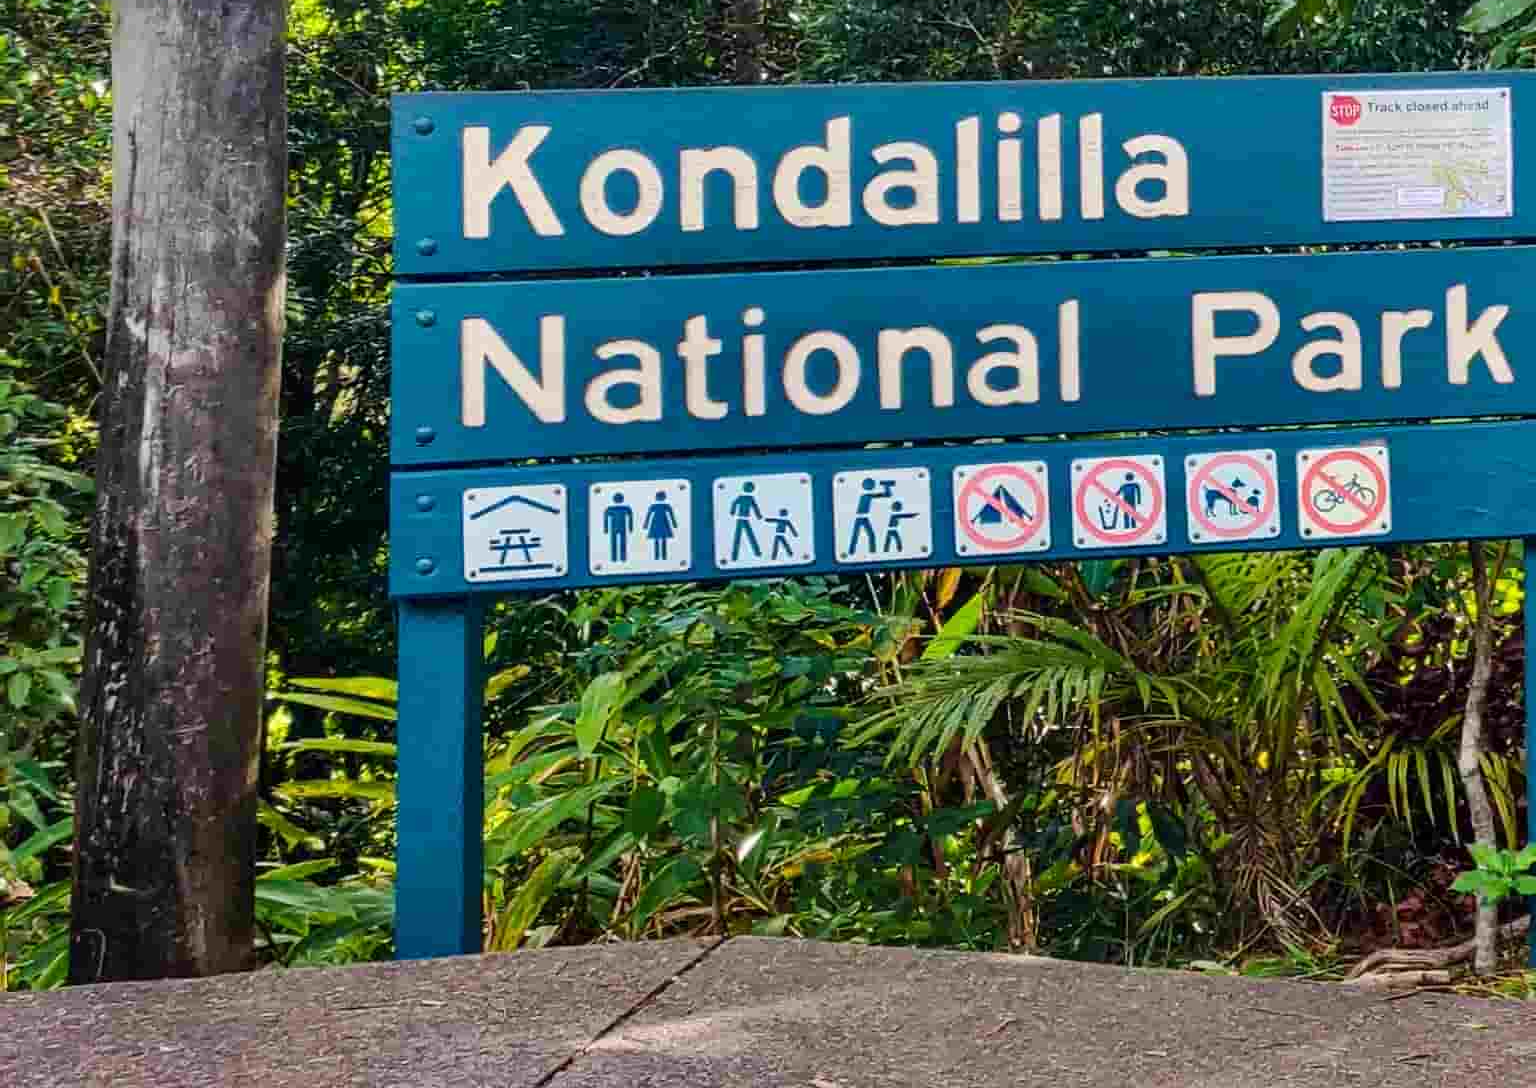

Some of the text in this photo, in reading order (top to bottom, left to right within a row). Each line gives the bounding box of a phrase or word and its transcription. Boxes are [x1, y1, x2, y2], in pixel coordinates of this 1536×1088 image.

[1330, 102, 1361, 118] STOP
[1367, 101, 1402, 113] Track
[1406, 100, 1448, 112] closed
[462, 112, 1189, 239] Kondalilla
[461, 284, 1514, 428] National Park
